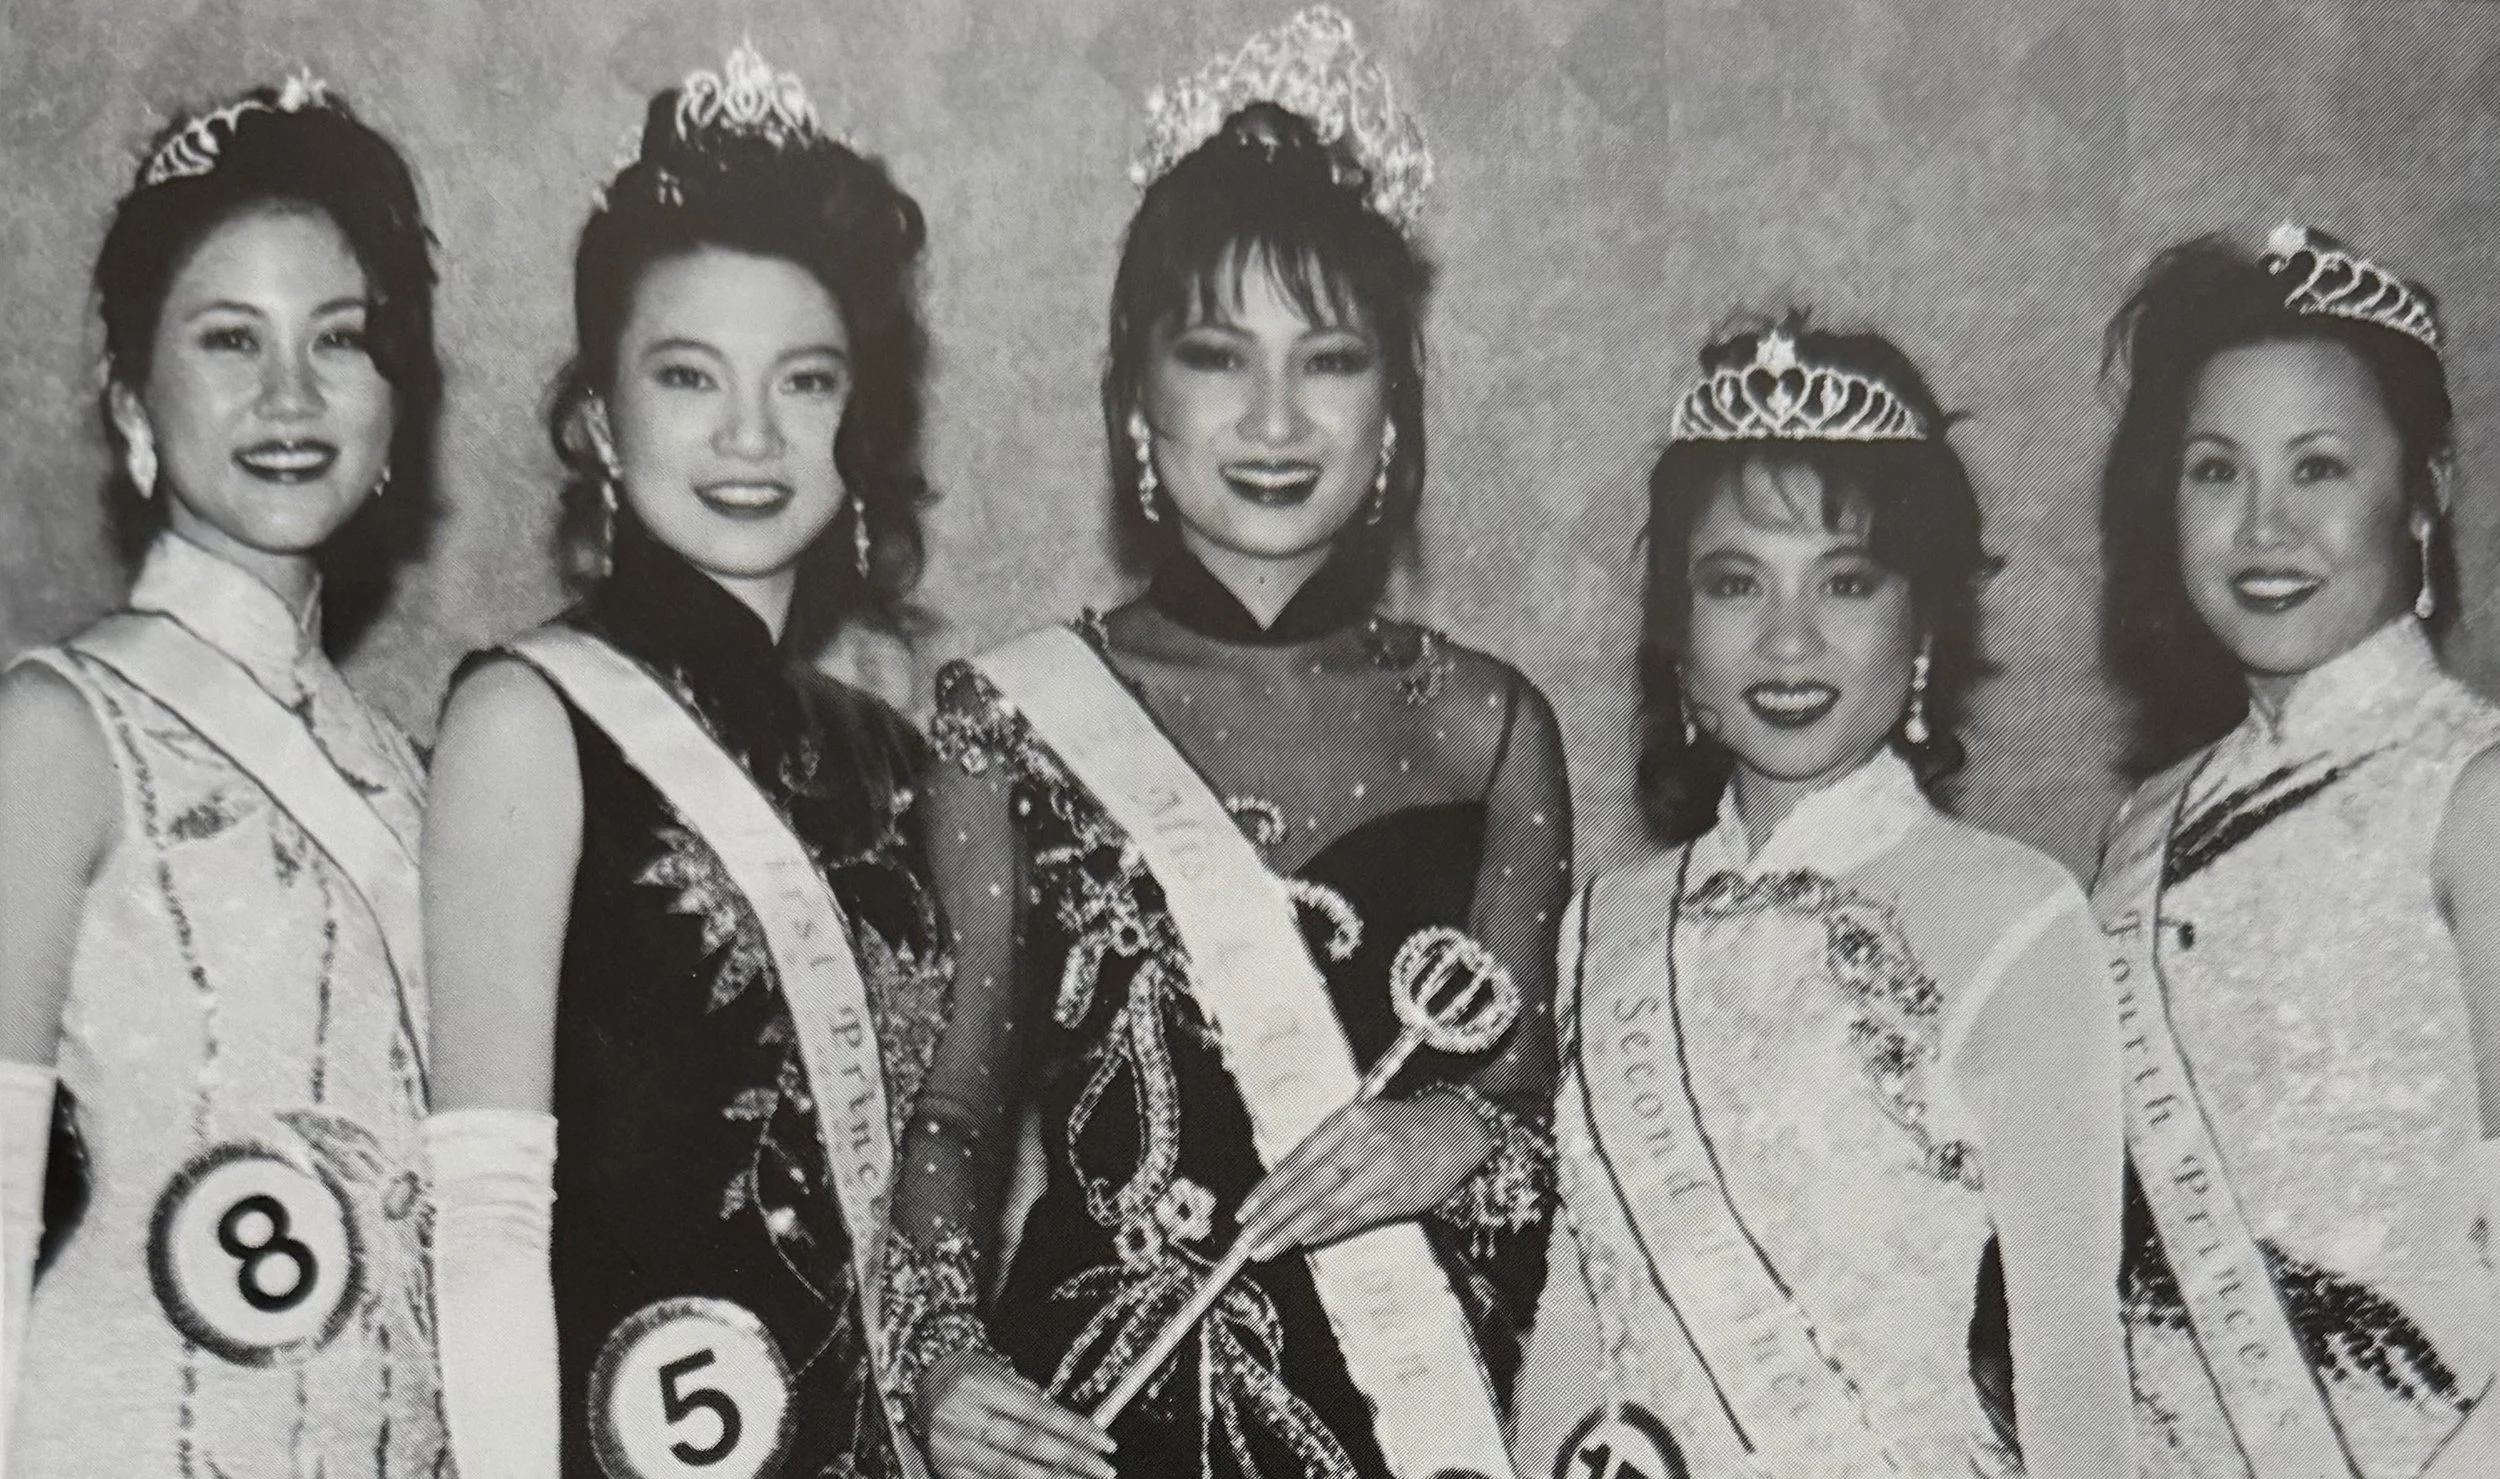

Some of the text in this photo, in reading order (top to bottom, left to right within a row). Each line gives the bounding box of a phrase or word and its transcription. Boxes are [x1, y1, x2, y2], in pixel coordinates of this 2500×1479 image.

[1612, 995, 1714, 1202] Second
[2098, 908, 2303, 1430] Fourth Princess
[217, 1194, 319, 1314] 8
[658, 1347, 743, 1468] 5
